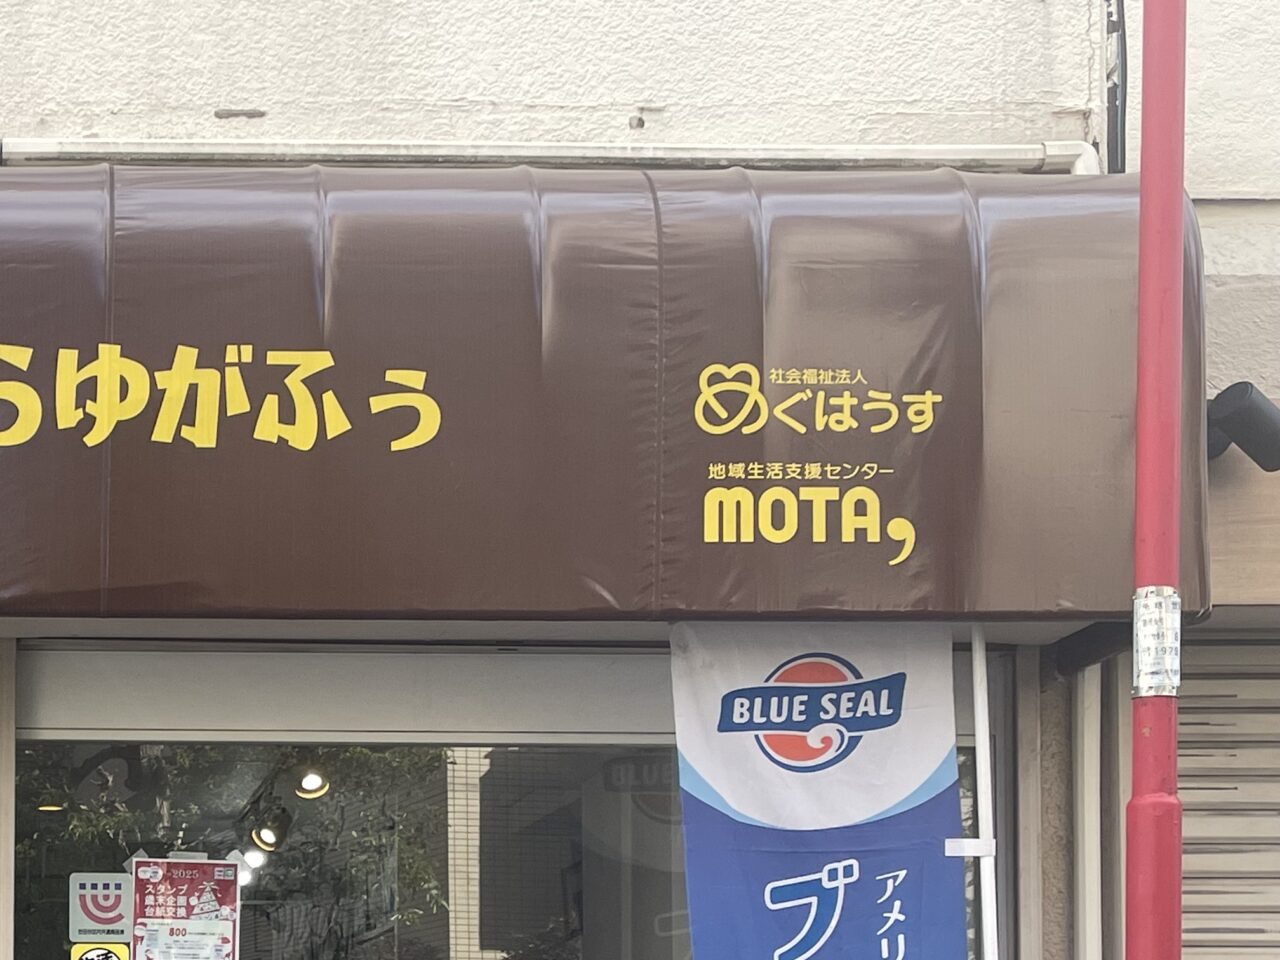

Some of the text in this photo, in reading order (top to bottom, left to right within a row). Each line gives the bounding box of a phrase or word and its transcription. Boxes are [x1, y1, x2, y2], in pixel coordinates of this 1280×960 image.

[769, 367, 868, 386] 社会福祉法人
[708, 462, 895, 481] 地域生活支援センター
[732, 689, 894, 725] BLUE SEAL
